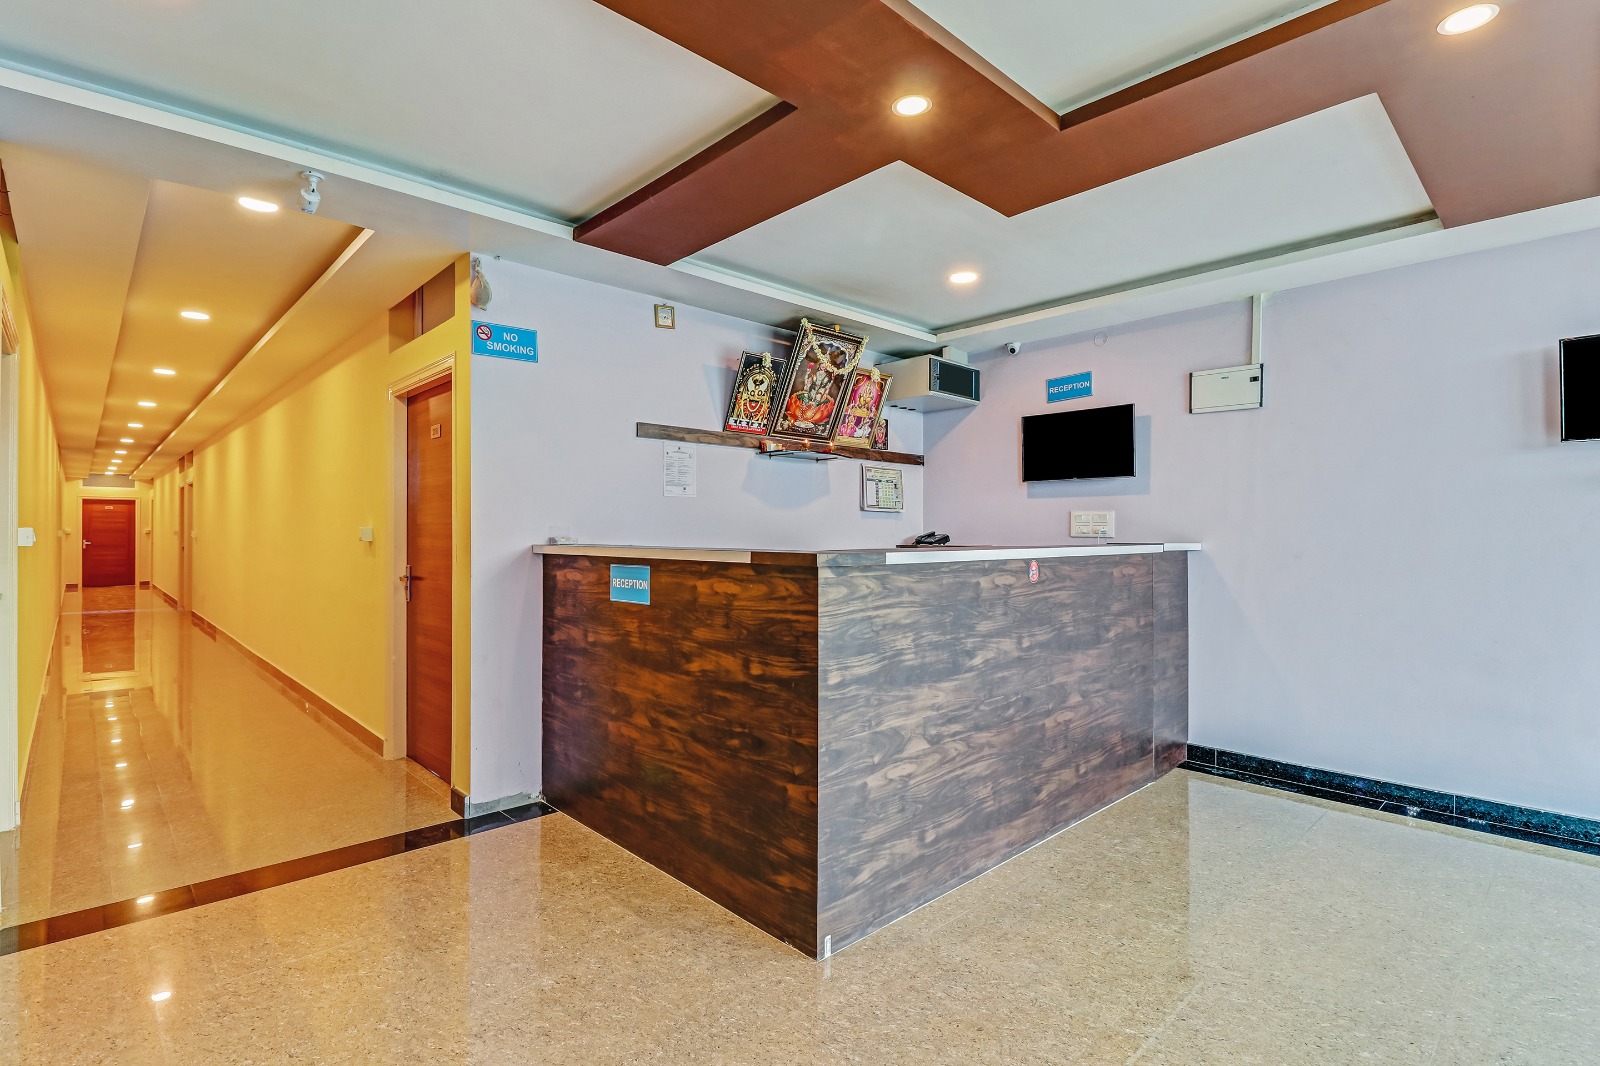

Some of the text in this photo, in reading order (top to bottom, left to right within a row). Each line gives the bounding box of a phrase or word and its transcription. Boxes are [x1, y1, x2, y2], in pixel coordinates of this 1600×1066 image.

[503, 332, 519, 342] NO
[486, 341, 534, 356] SMOKING
[1049, 380, 1090, 394] RECEPTION
[612, 578, 648, 590] RECEPTION
